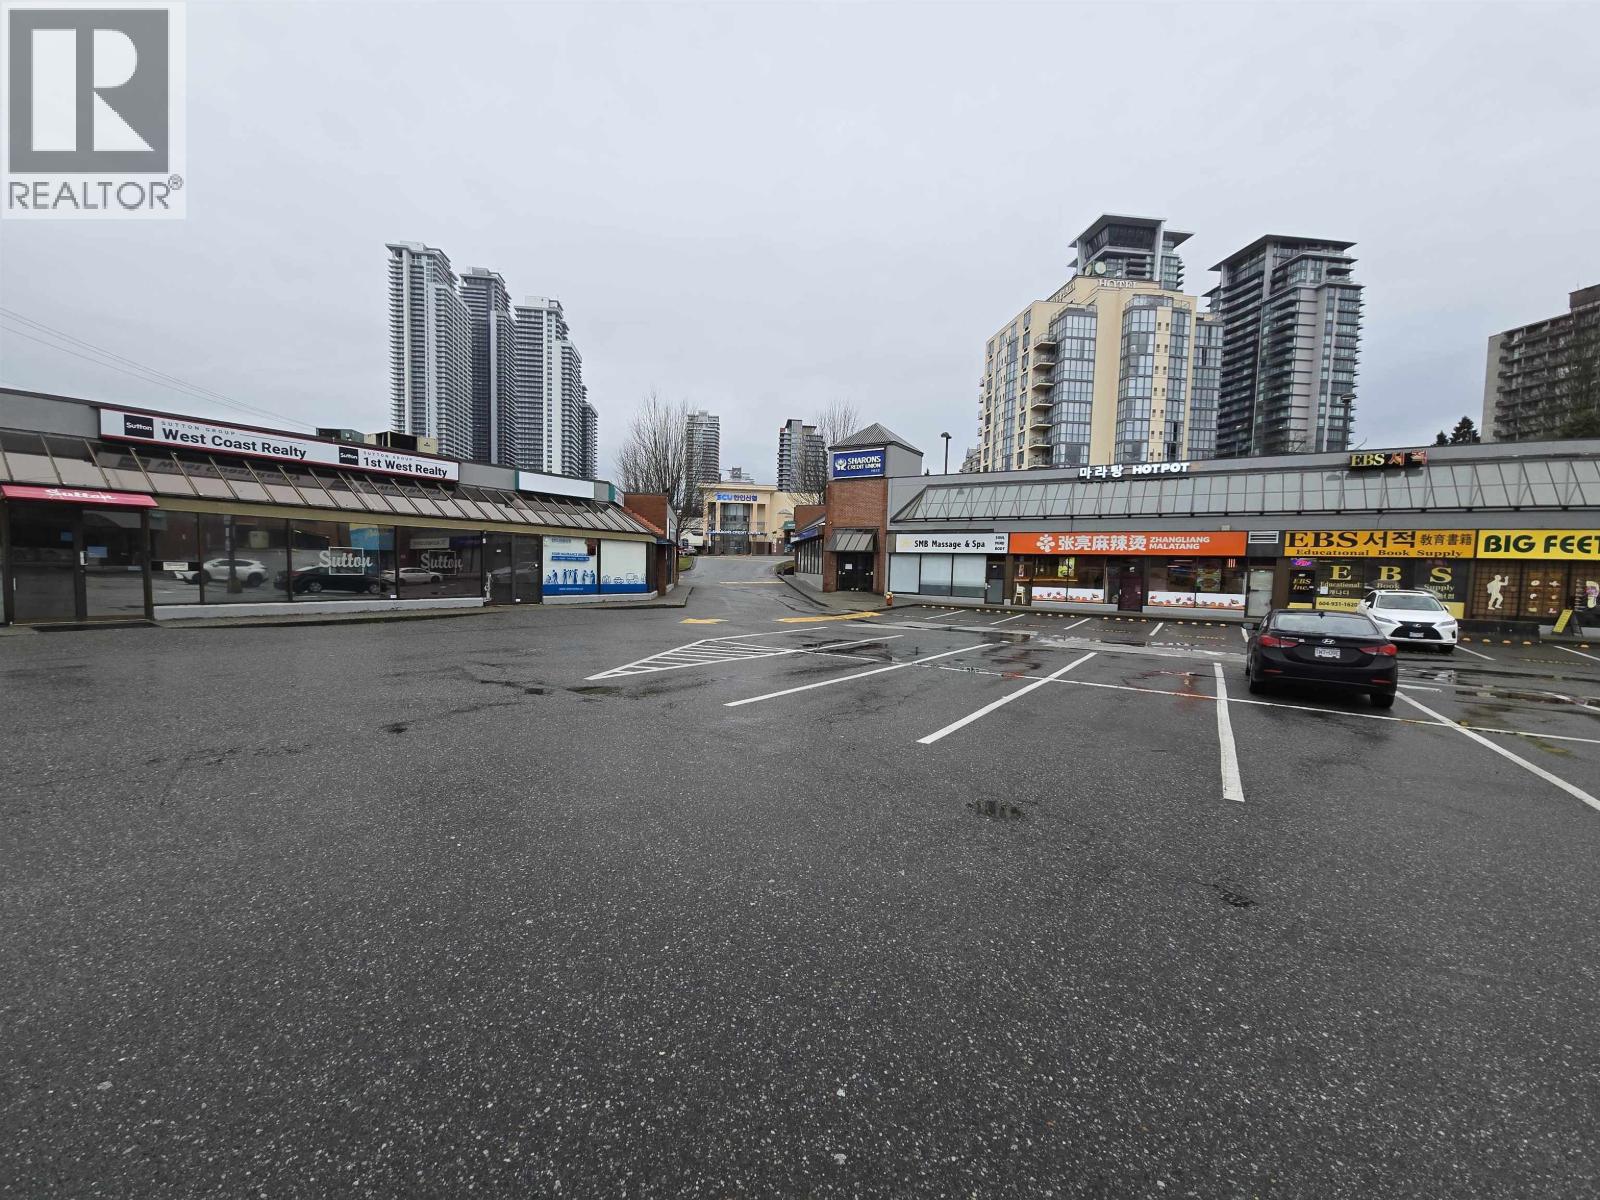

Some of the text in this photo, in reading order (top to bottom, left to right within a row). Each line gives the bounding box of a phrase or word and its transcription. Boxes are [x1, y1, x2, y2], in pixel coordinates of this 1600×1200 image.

[126, 421, 153, 431] Sutton
[161, 420, 236, 436] SUTTON GROUP
[162, 427, 307, 460] West Coast Realty
[339, 452, 358, 460] Sutton
[847, 456, 882, 465] SHARONS
[1351, 453, 1385, 467] EBS
[363, 457, 448, 478] 1st West Realty
[1131, 462, 1190, 475] HOTPOT
[44, 488, 117, 501] Sutton
[914, 539, 986, 549] SMB Massage & Spa
[1058, 535, 1147, 551] 张亮麻辣烫
[1483, 534, 1536, 553] BIG
[319, 549, 374, 568] Sutton
[420, 553, 464, 570] Sutton
[1329, 565, 1453, 583] E B S
[1320, 581, 1361, 589] Educational
[1424, 583, 1455, 591] Supply
